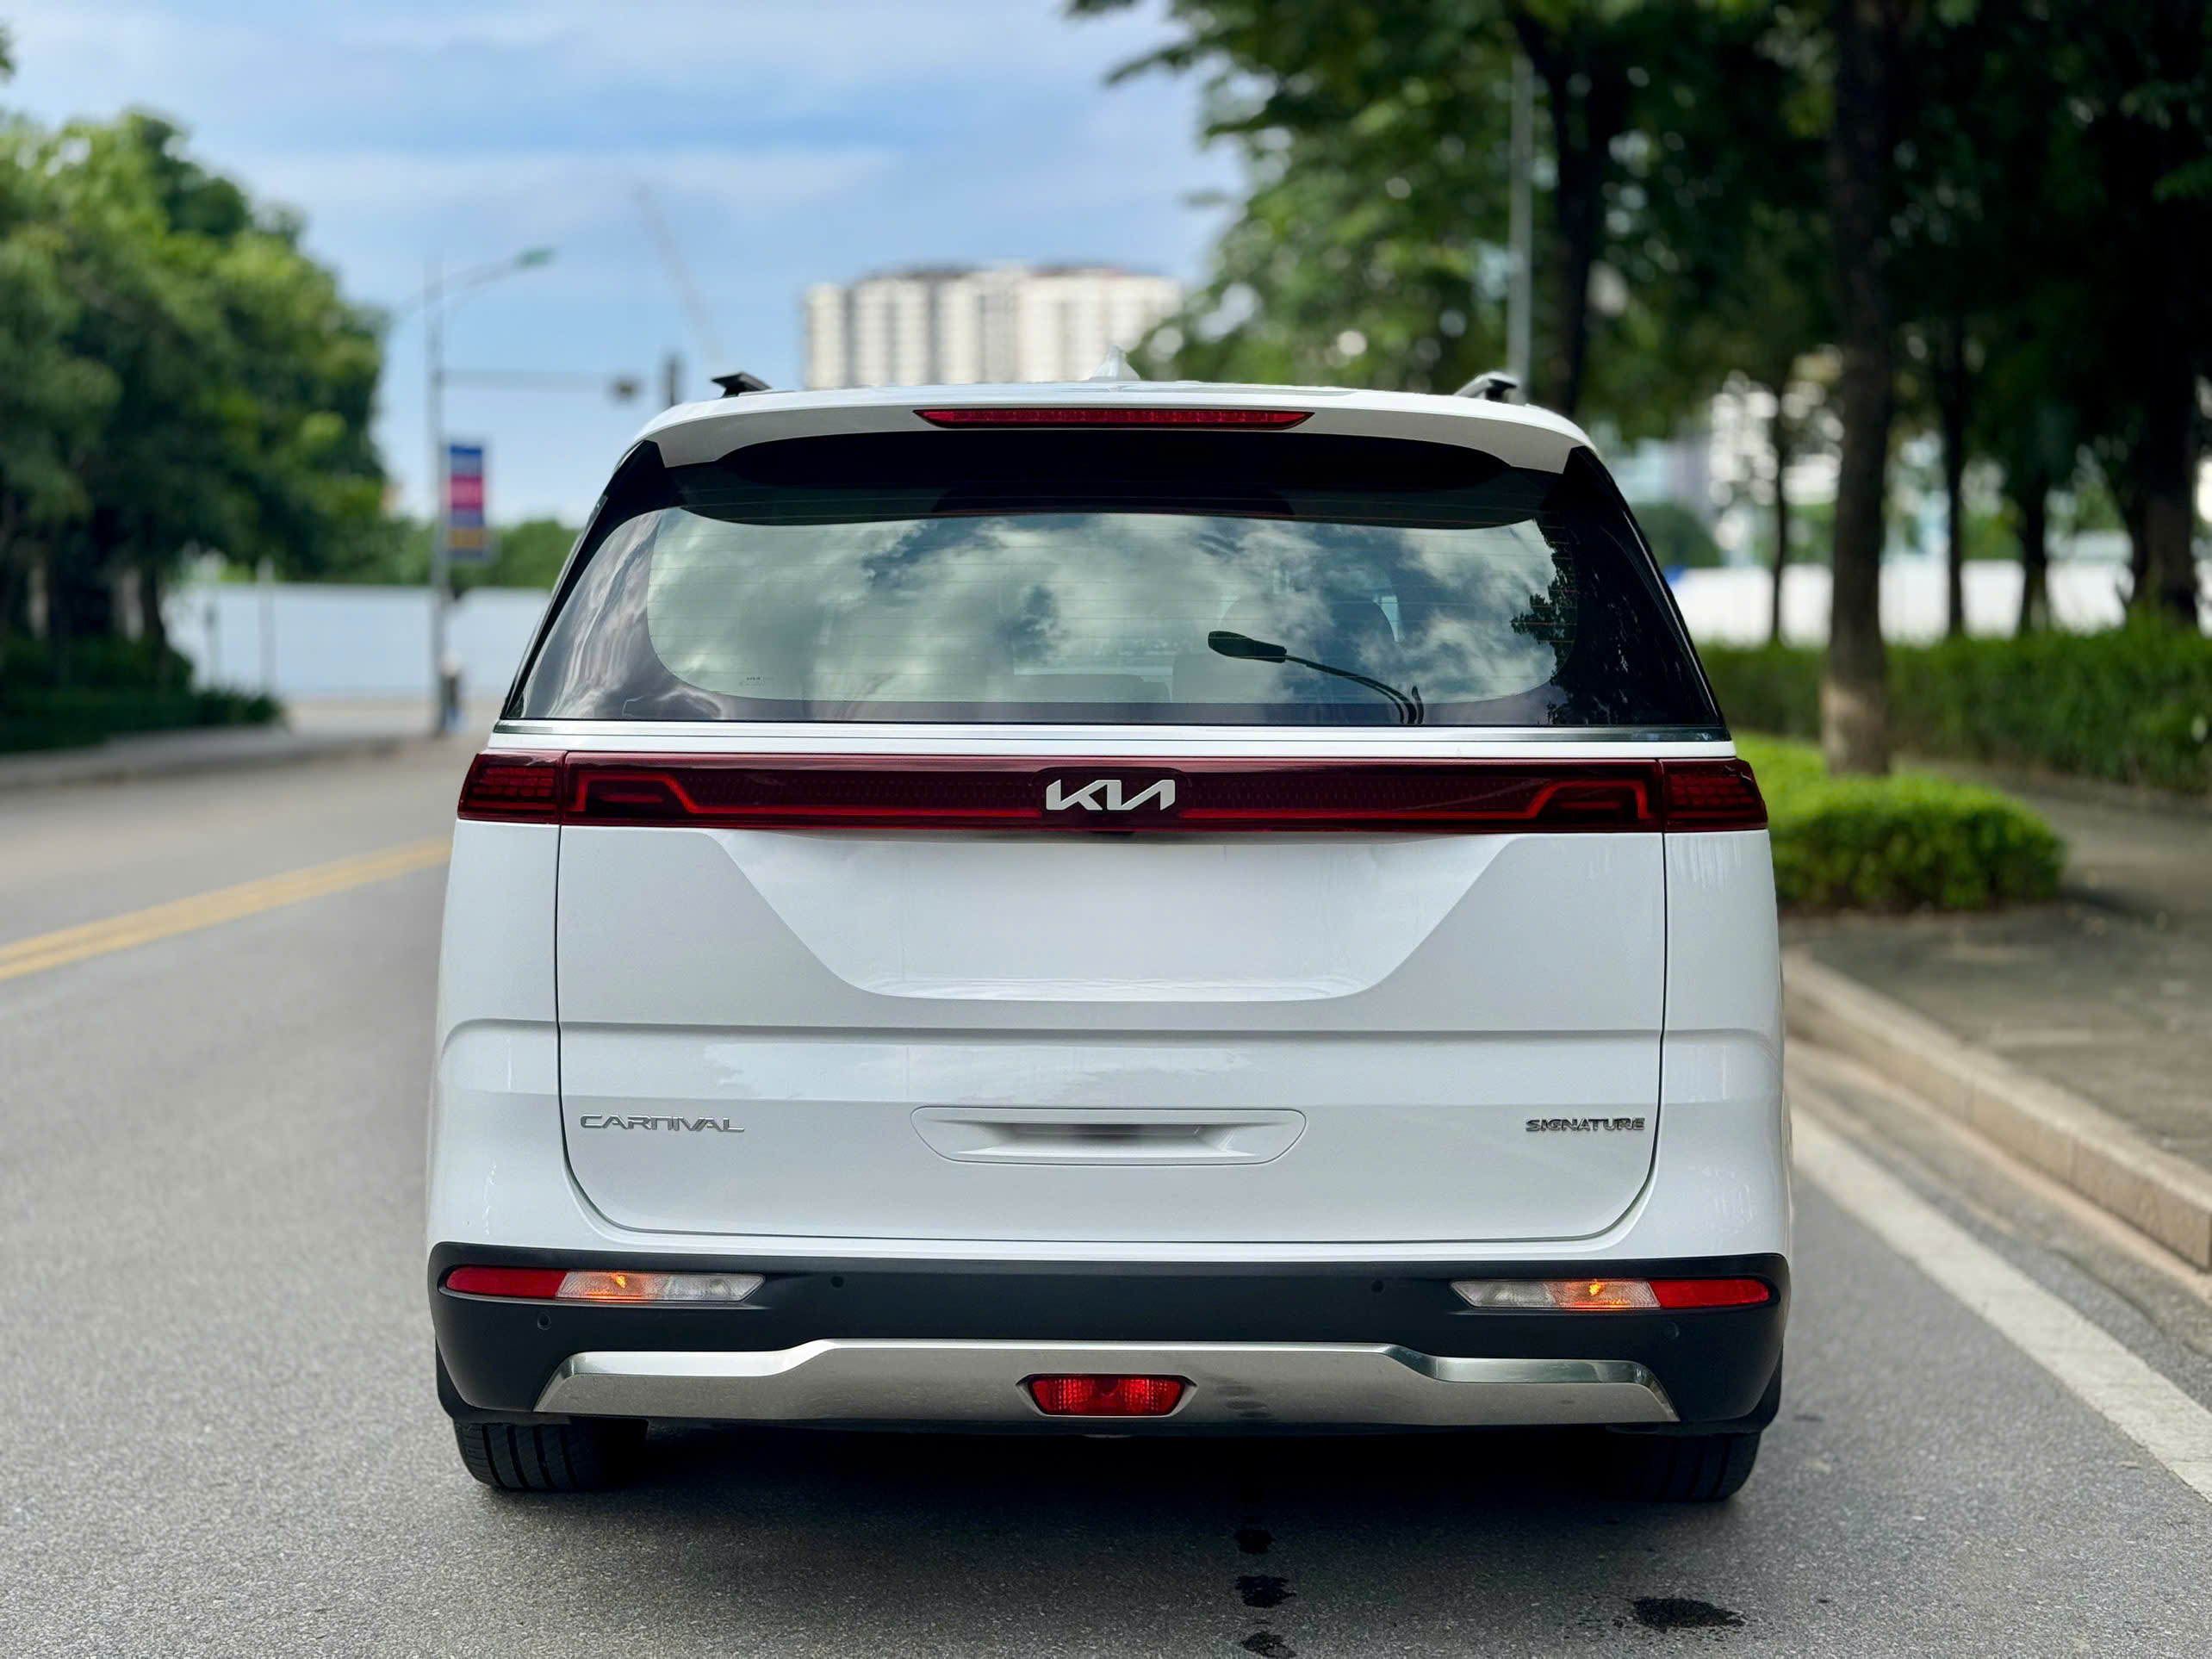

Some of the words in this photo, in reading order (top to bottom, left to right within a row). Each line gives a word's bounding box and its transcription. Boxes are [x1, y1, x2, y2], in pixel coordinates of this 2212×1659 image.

[1046, 779, 1176, 811] KIA
[580, 1114, 745, 1133] CARNIVAL
[1525, 1117, 1645, 1132] SIGNATURE
